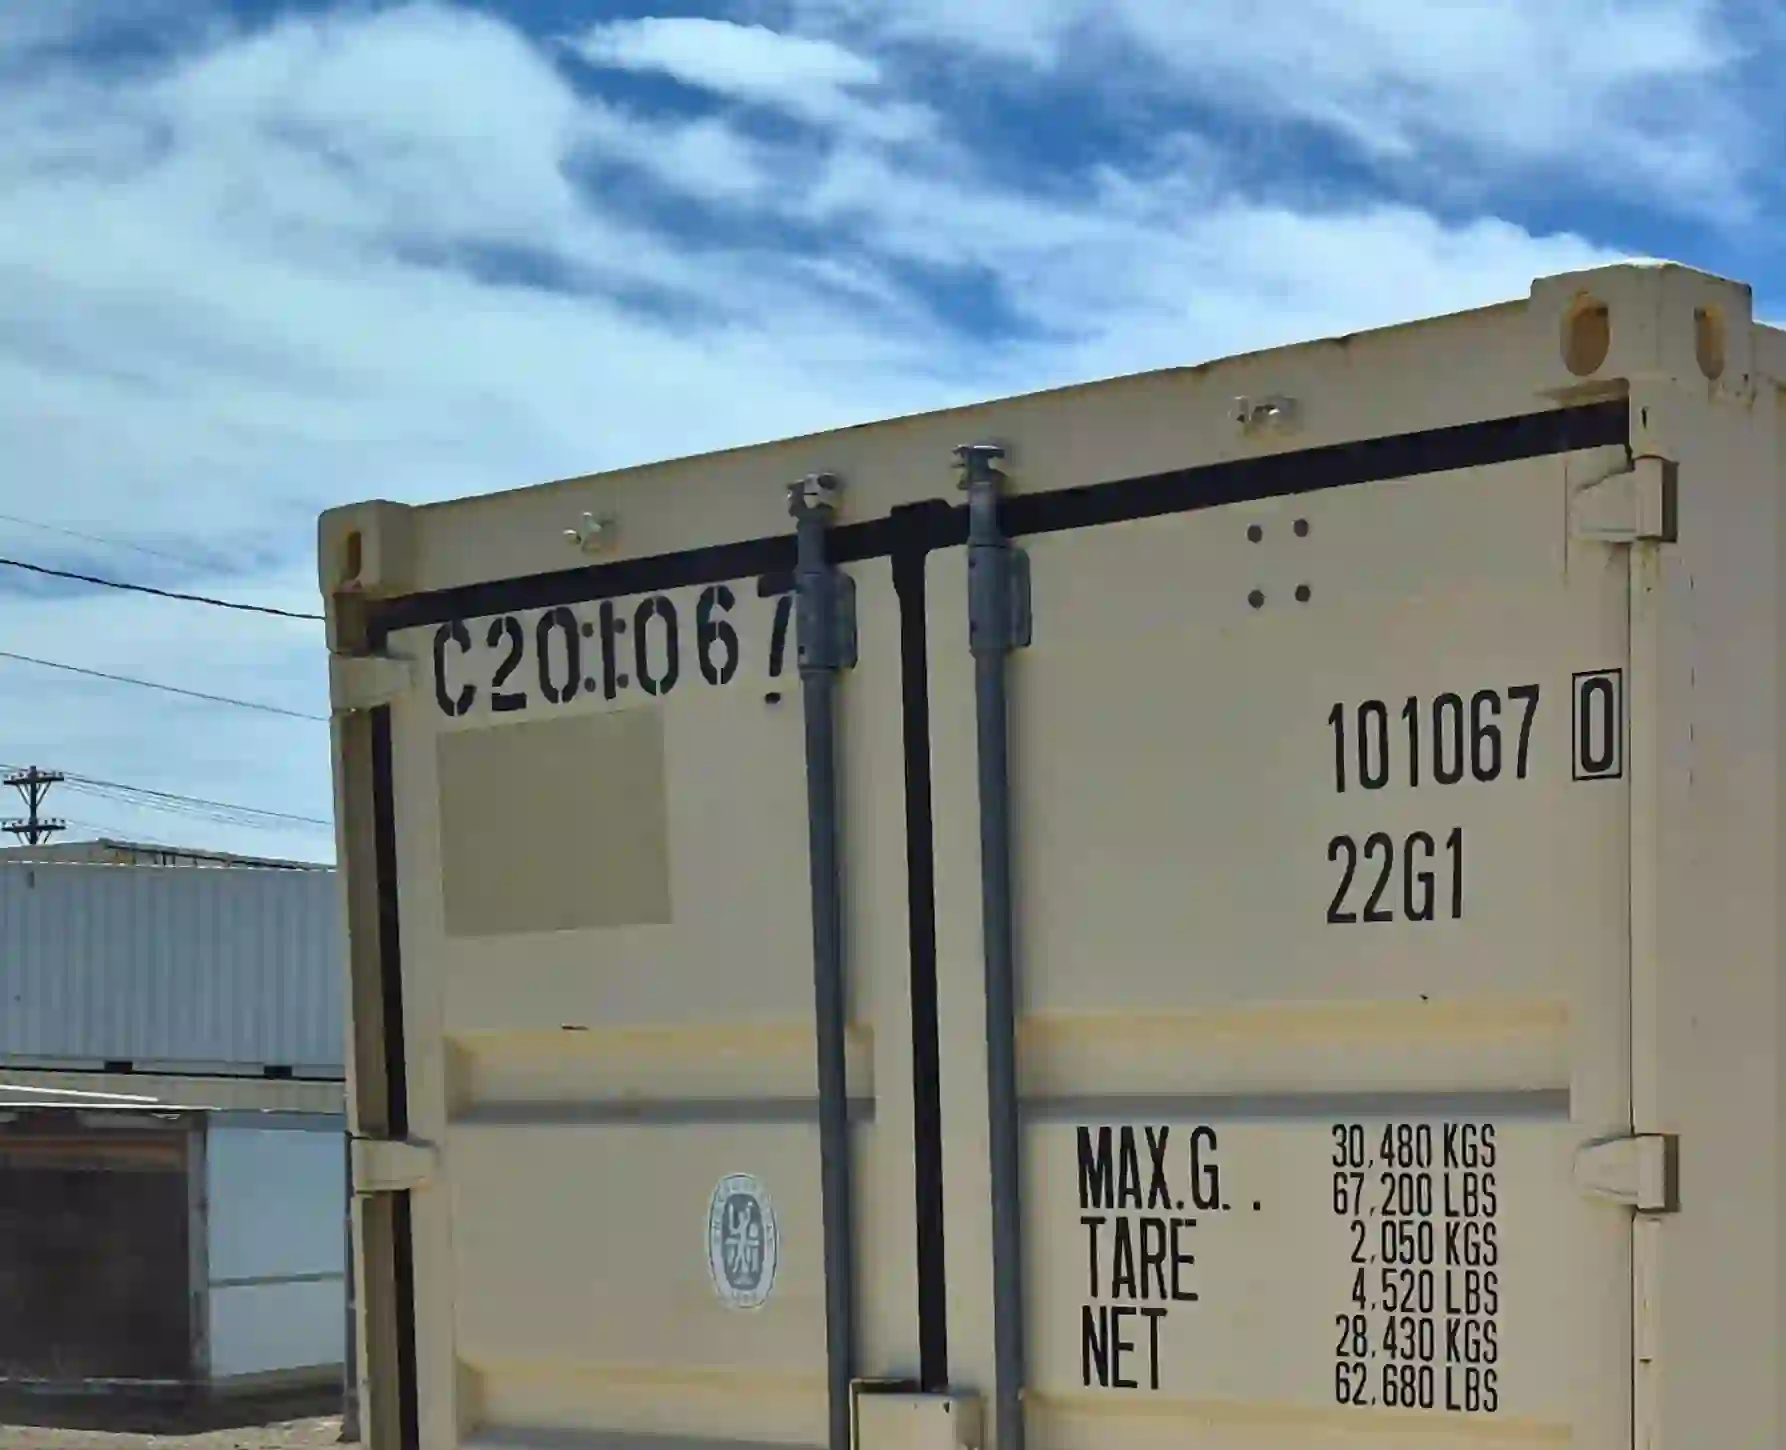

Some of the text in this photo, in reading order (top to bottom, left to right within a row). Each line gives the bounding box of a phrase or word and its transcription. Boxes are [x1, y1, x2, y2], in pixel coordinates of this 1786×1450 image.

[1328, 683, 1540, 793] 101067
[1327, 827, 1462, 924] 22G1
[1332, 1123, 1496, 1169] 30,480 KGS
[1333, 1171, 1497, 1218] 67,200 LBS
[1080, 1216, 1199, 1301] TARE
[1350, 1219, 1498, 1267] 2,050 KGS
[1352, 1267, 1498, 1316] 4,520 LBS
[1082, 1305, 1168, 1390] NET
[1335, 1313, 1498, 1365] 28,430 KGS
[1335, 1360, 1498, 1413] 62,680 LBS
